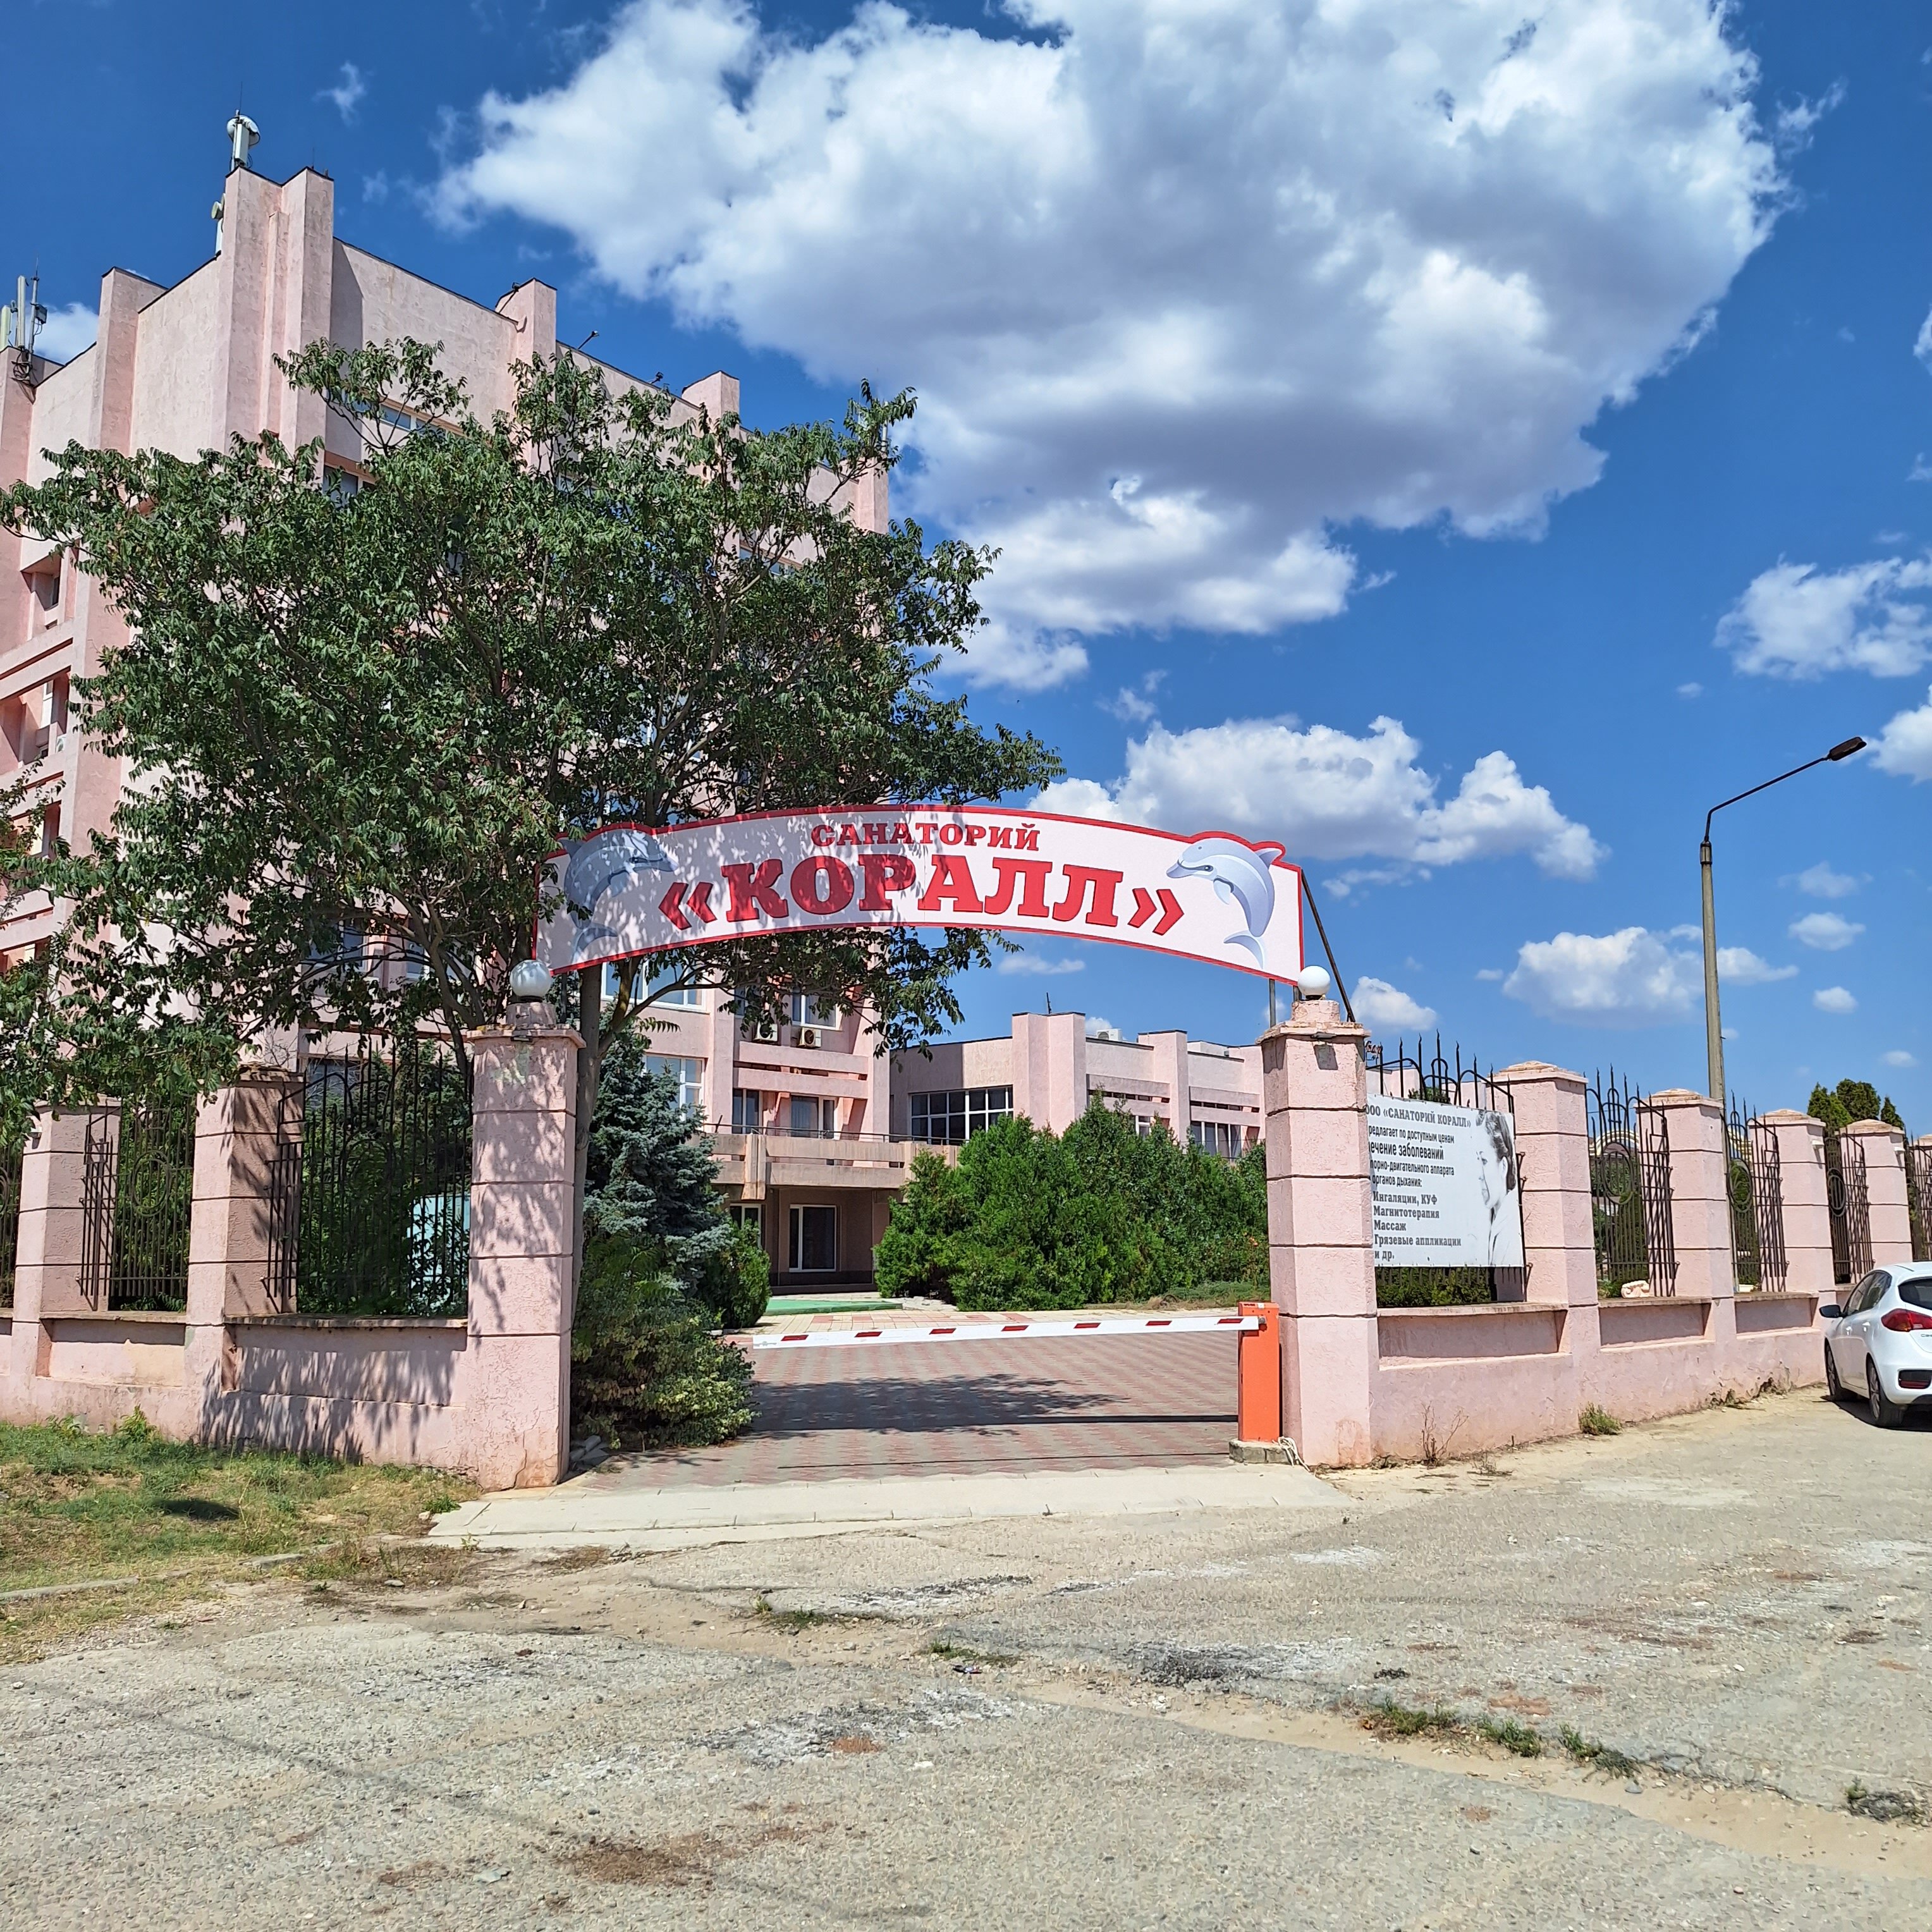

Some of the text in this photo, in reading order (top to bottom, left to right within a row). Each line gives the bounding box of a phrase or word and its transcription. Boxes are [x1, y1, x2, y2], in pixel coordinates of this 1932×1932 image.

[810, 823, 1040, 851] САНАТОРИЙ
[658, 854, 1184, 936] «КОРАЛЛ»
[1366, 1104, 1471, 1128] ООО «САНАТОРИЙ КОРАЛЛ»
[1369, 1125, 1455, 1145] редлагает по доступным ценам
[1398, 1142, 1444, 1160] заболеваний
[1370, 1159, 1455, 1178] порно-двигательного аппарата
[1373, 1175, 1422, 1187] органов дыхания:
[1373, 1191, 1438, 1206] Ингаляции, КУФ
[1374, 1206, 1440, 1220] Магнитотерапия
[1374, 1220, 1407, 1231] Массаж
[1374, 1234, 1461, 1247] Грязевые аппликации
[1374, 1250, 1395, 1261] и др.
